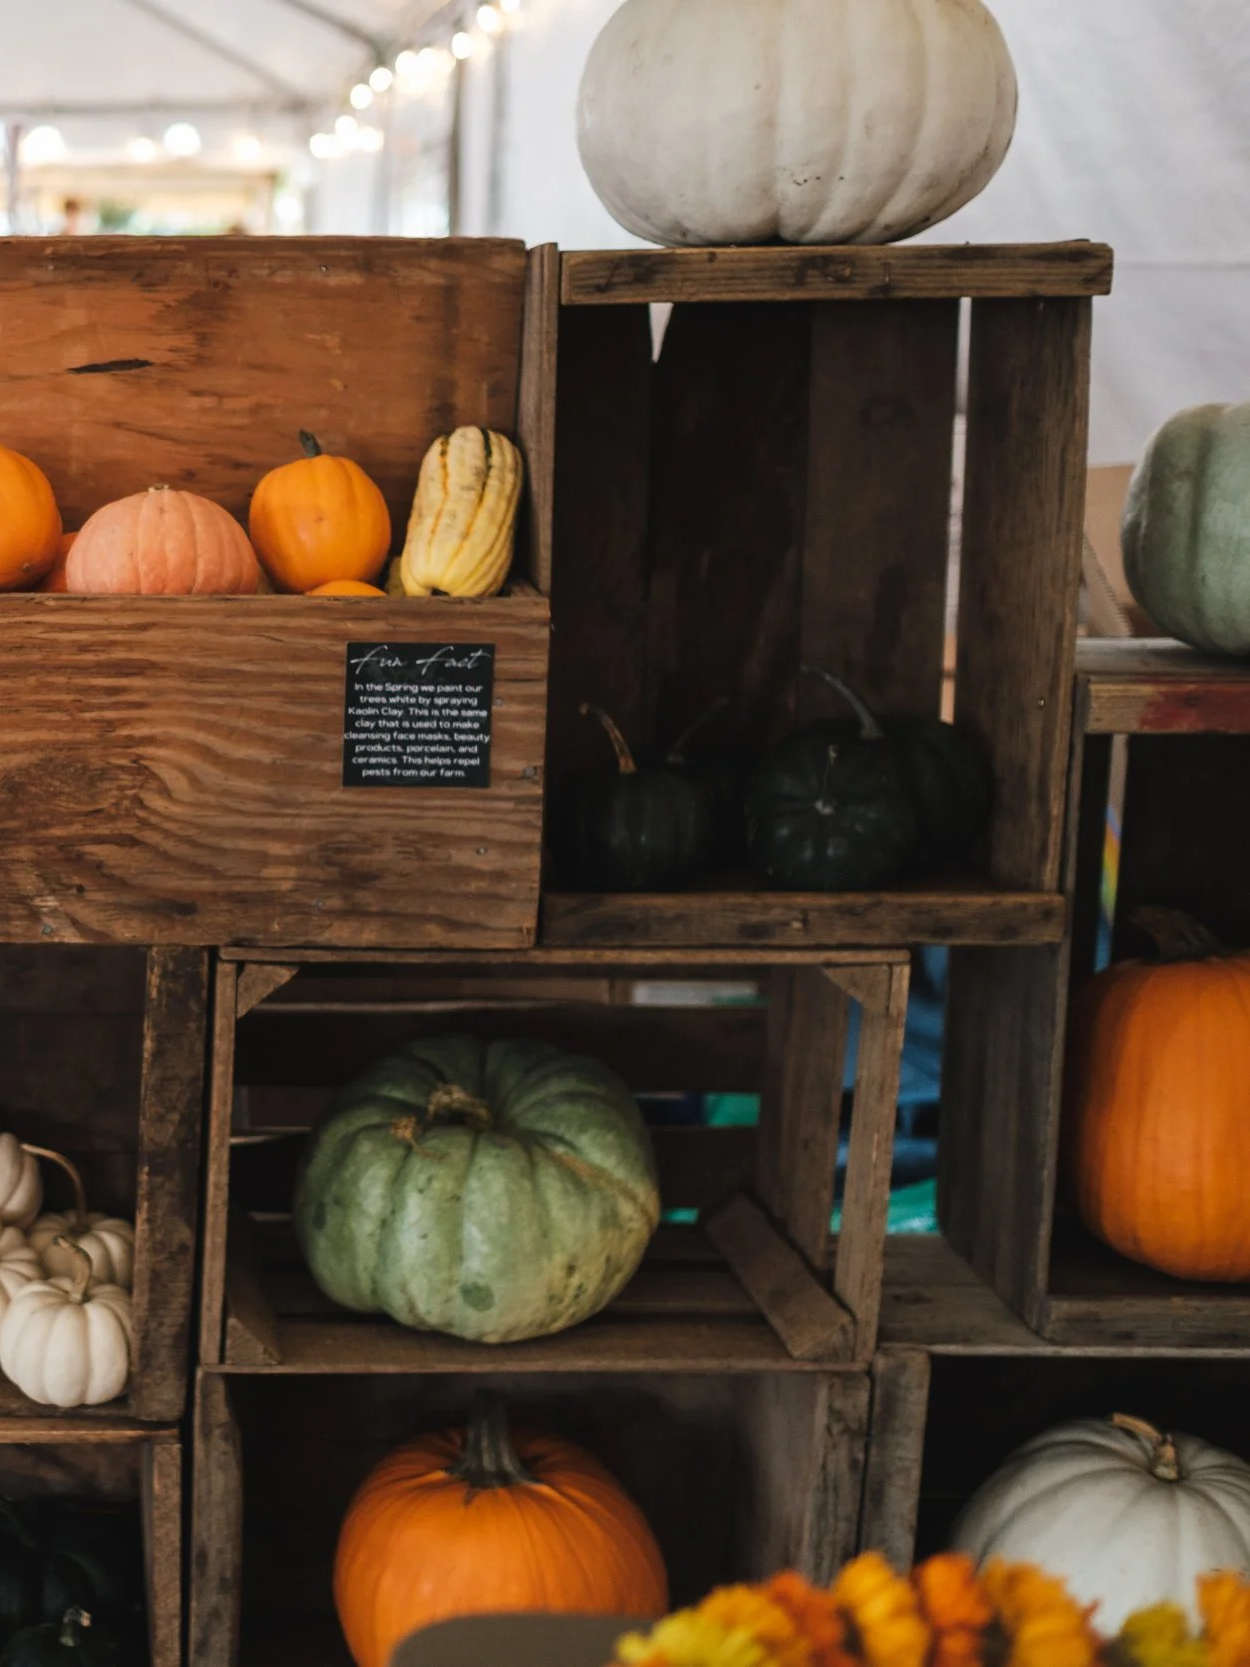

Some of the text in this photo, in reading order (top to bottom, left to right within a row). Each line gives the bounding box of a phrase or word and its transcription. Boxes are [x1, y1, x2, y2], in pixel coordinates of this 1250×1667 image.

[350, 645, 491, 676] fun fact
[366, 683, 382, 691] the
[385, 683, 418, 693] Spring
[437, 684, 462, 693] paint
[389, 696, 416, 704] white
[418, 696, 431, 705] by
[434, 697, 478, 706] spraying
[348, 707, 379, 715] Kaolin
[409, 707, 429, 716] This
[432, 708, 439, 716] is
[442, 708, 458, 716] the
[355, 719, 479, 729] clay that is used to make
[344, 732, 390, 742] cleansing
[393, 732, 415, 740] face
[454, 733, 490, 743] beauty
[458, 745, 478, 753] and
[402, 756, 422, 764] This
[424, 757, 451, 766] helps
[454, 757, 480, 766] repel
[362, 768, 390, 778] pests
[393, 768, 417, 776] from
